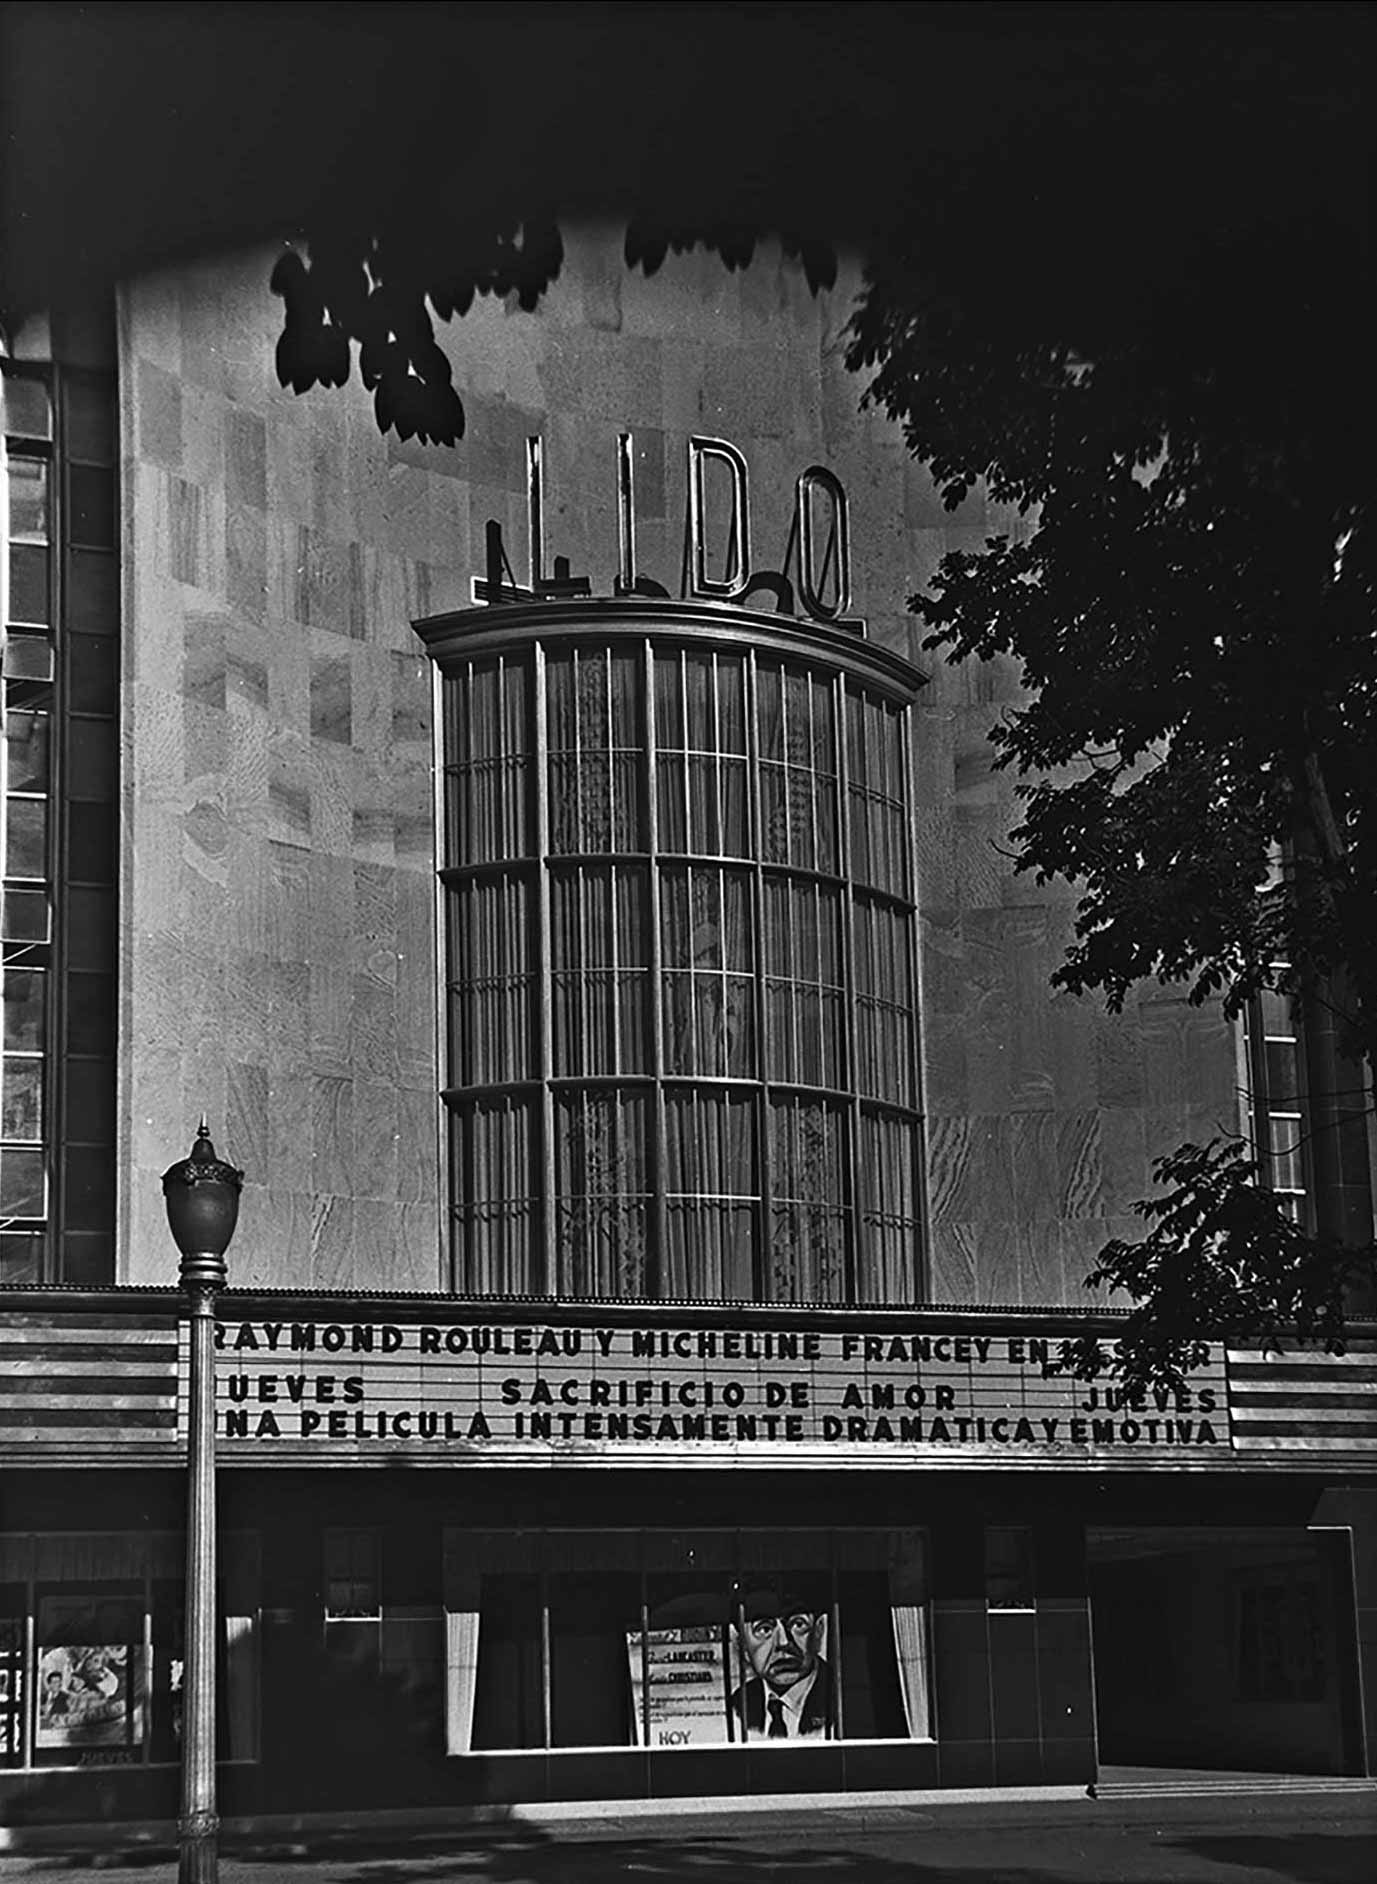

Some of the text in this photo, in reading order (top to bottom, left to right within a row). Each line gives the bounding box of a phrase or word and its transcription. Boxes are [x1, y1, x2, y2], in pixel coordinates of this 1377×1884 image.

[527, 434, 852, 621] LIDO
[420, 1326, 582, 1356] ROULEAU
[595, 1328, 615, 1356] Y
[633, 1329, 821, 1360] MICHELINE
[843, 1336, 994, 1362] FRANCEY
[1009, 1338, 1048, 1364] EN
[214, 1375, 364, 1403] UEVES
[502, 1378, 744, 1408] SACRIFICIO
[767, 1383, 810, 1408] DE
[841, 1383, 955, 1410] AMOR
[214, 1410, 281, 1437] NA
[301, 1410, 492, 1439] PELICULA
[516, 1411, 804, 1441] INTENSAMENTE
[1071, 1419, 1216, 1444] EMOTIVA
[659, 1731, 691, 1745] HOY
